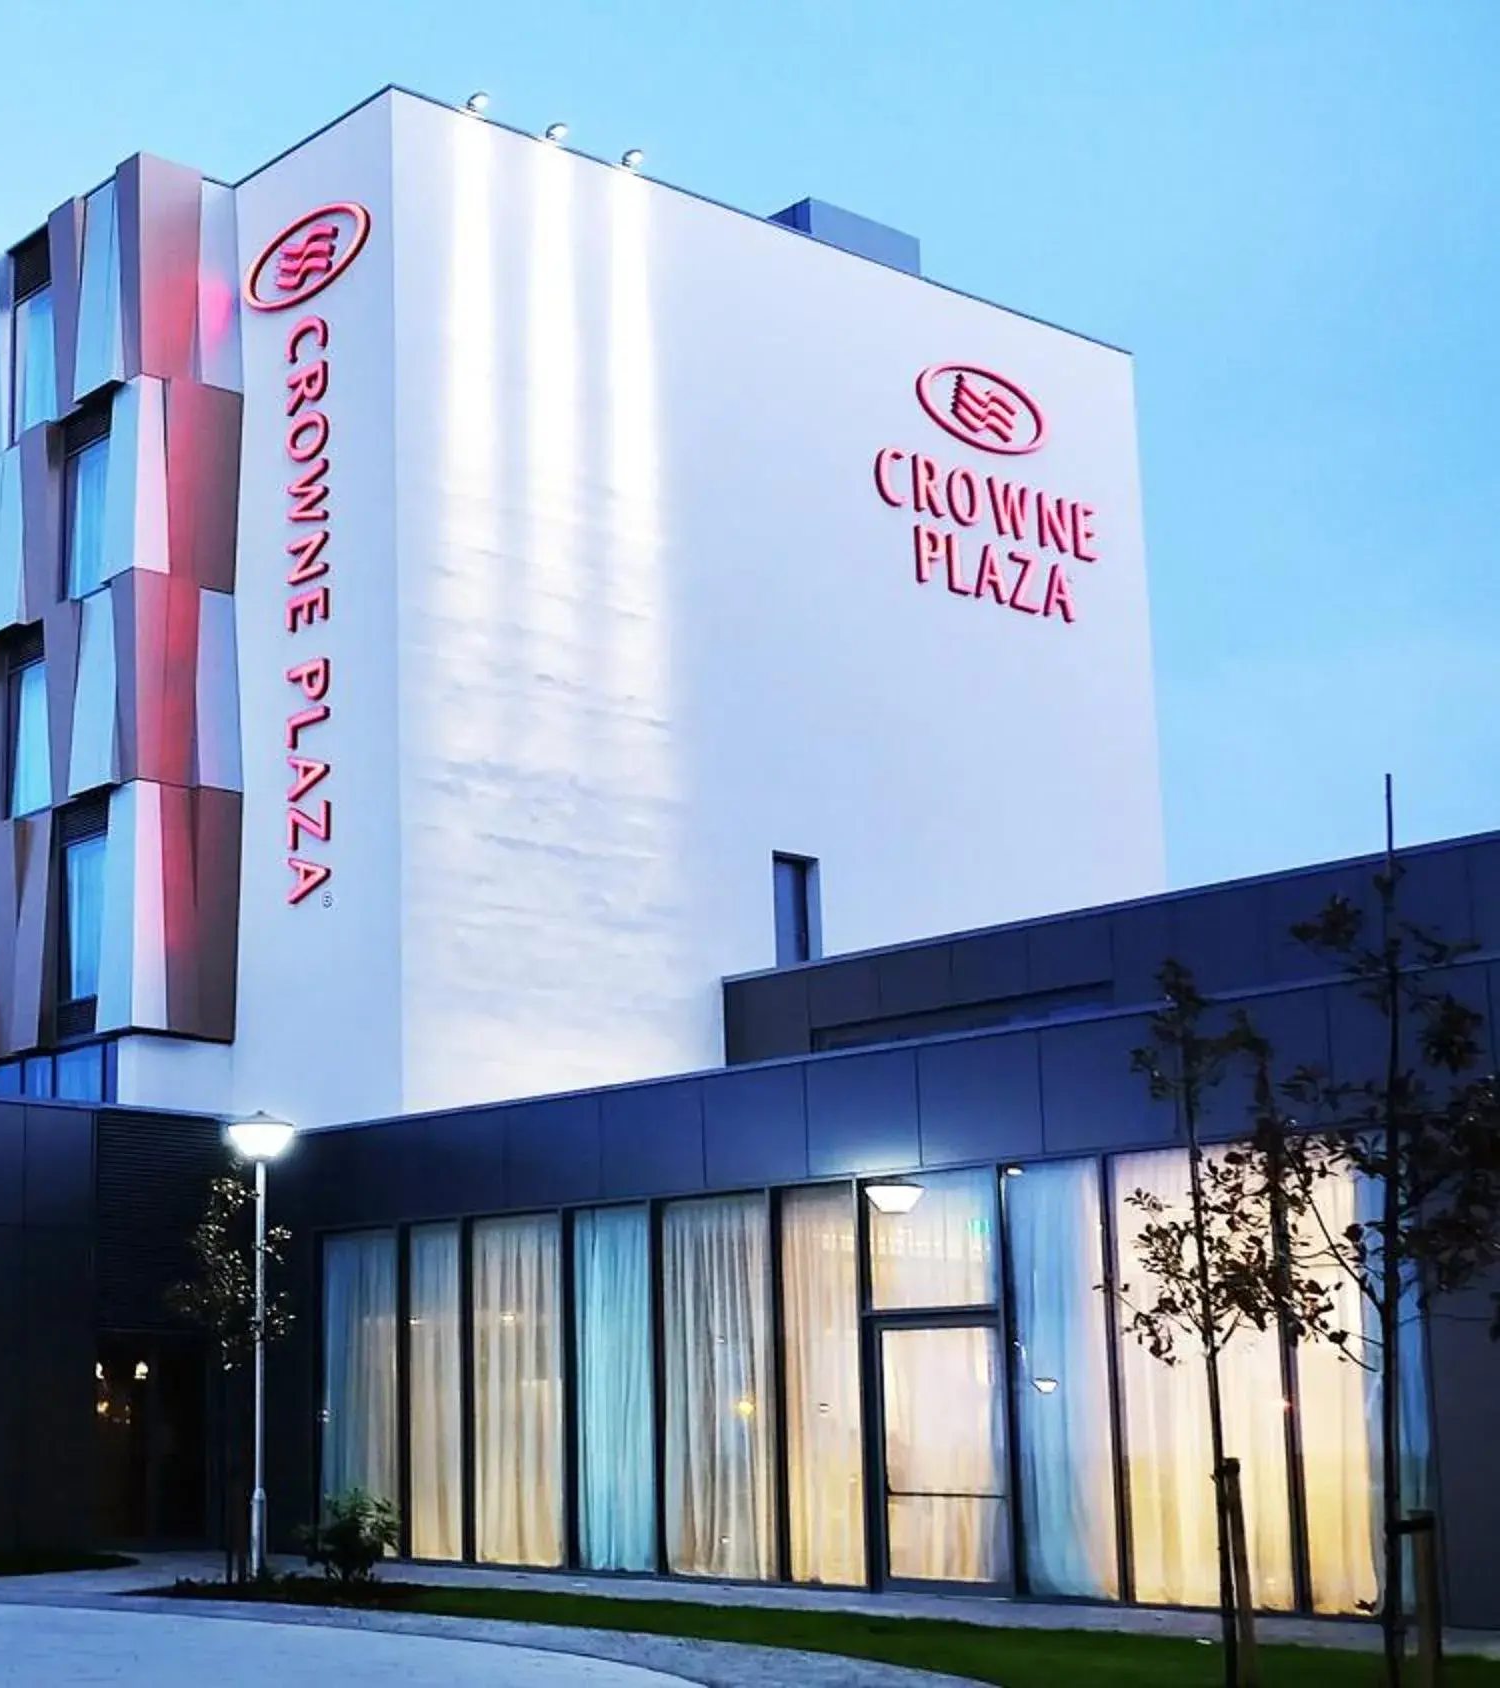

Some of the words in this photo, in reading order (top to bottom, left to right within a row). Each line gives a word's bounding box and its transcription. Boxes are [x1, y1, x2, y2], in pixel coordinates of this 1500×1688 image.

[287, 316, 329, 633] CROWNE
[874, 447, 1099, 562] CROWNE
[914, 524, 1076, 623] PLAZA
[287, 657, 331, 905] PLAZA
